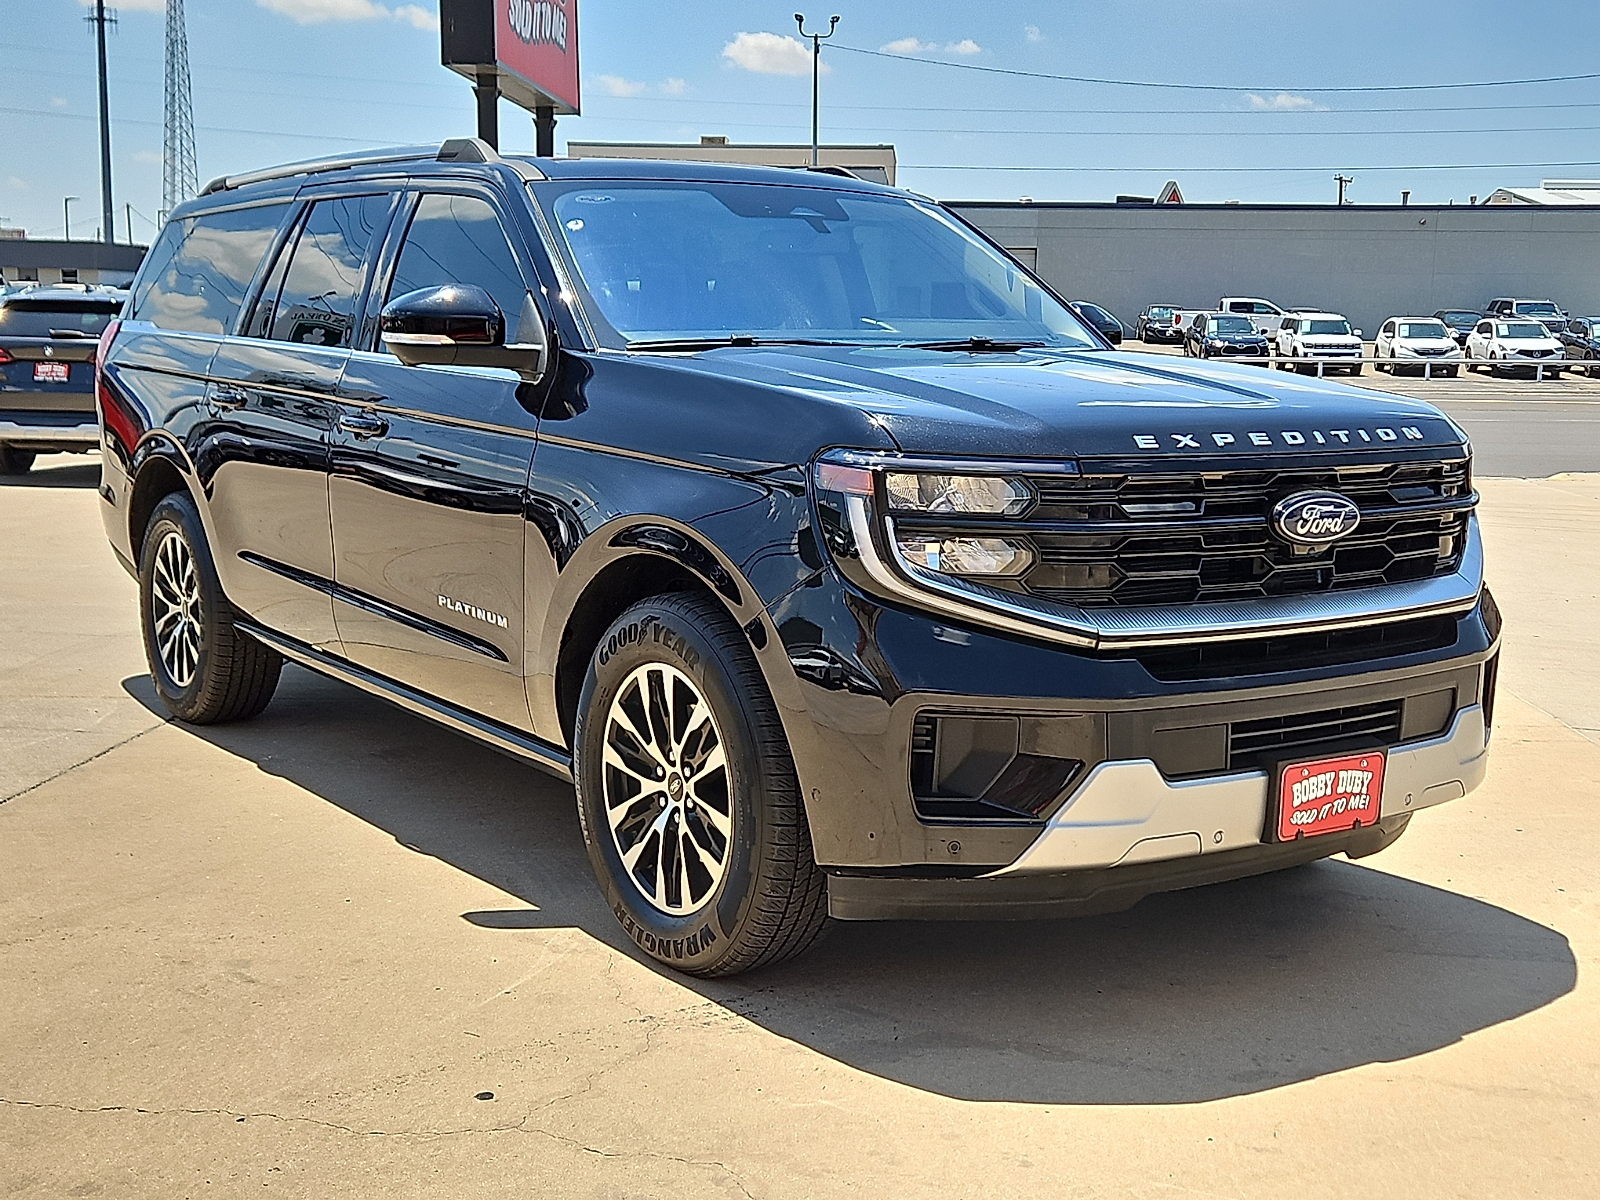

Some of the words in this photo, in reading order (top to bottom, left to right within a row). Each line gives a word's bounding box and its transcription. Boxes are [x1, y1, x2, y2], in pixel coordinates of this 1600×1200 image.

[1132, 427, 1423, 449] EXPEDITION
[1298, 504, 1345, 535] Ford
[437, 594, 509, 629] PLATINUM
[1291, 771, 1336, 808] BOBBY
[1336, 769, 1374, 795] DUBY
[1289, 808, 1317, 825] SOLD
[1317, 802, 1332, 821] IT
[1331, 797, 1347, 816] TO
[1347, 794, 1371, 811] ME!
[612, 902, 717, 959] WRANGLER
